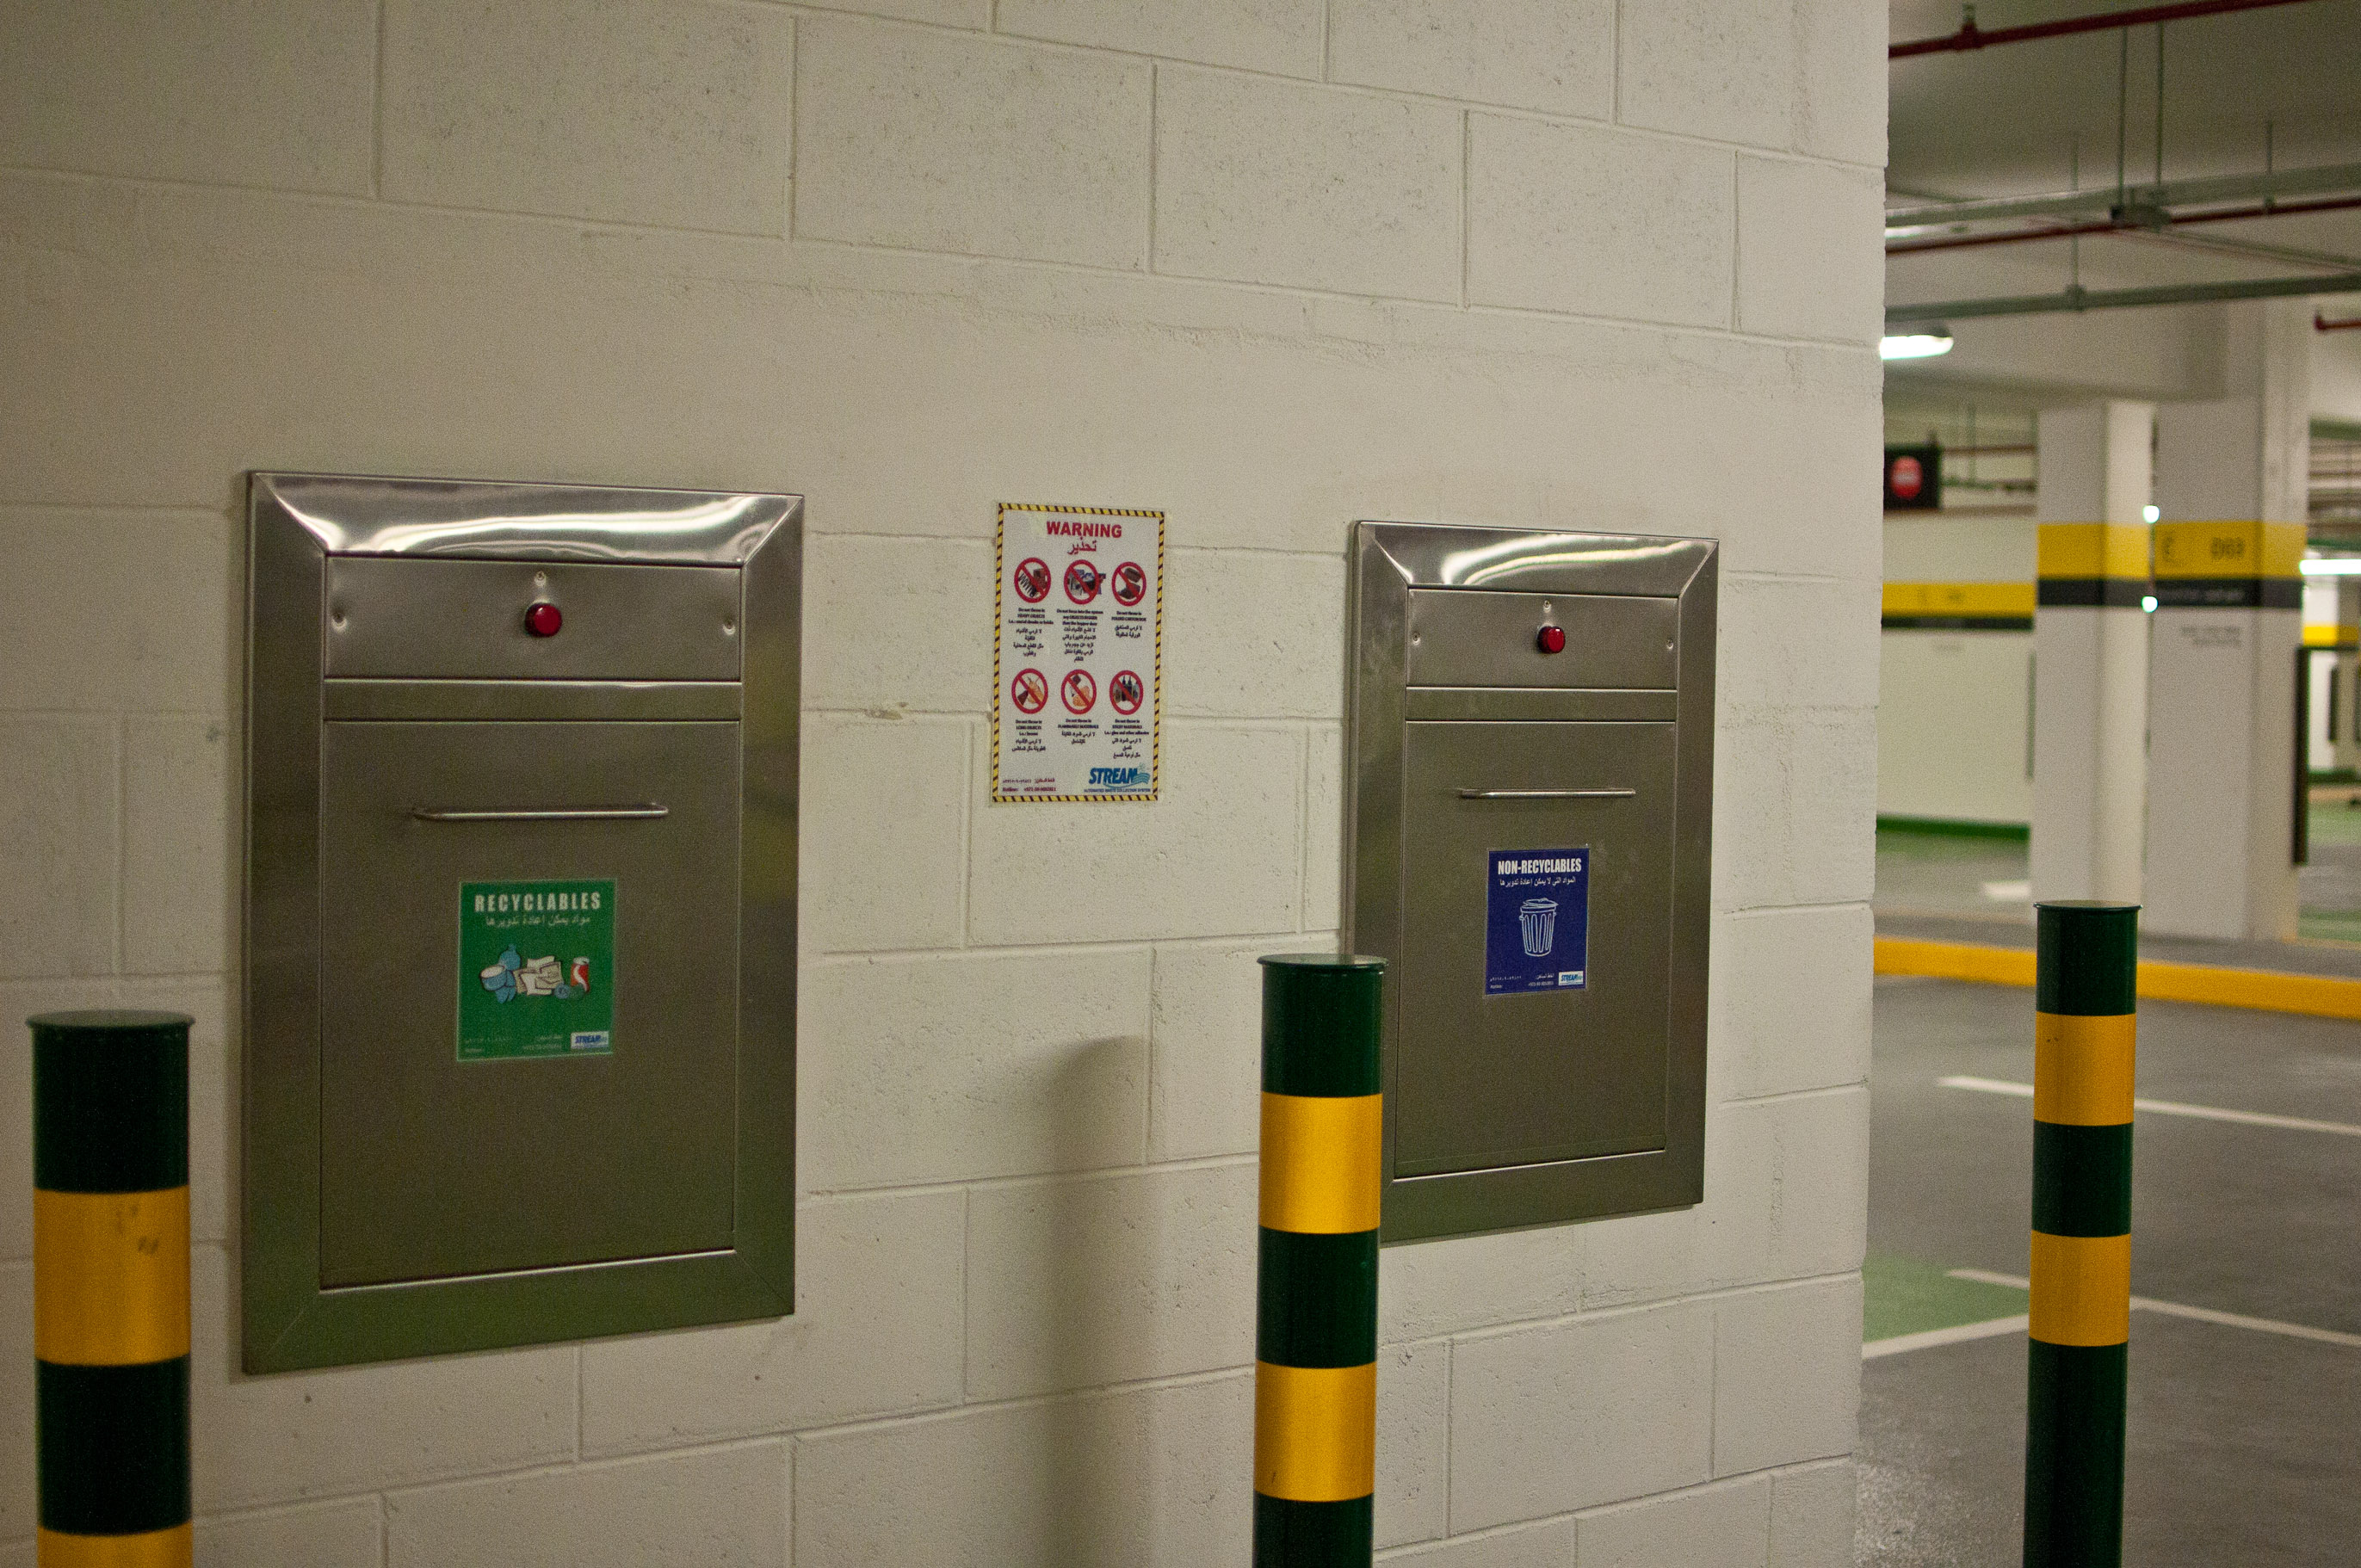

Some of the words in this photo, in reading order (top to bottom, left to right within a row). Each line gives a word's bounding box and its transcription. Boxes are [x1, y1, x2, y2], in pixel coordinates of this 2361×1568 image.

[1046, 521, 1122, 538] WARNING
[1067, 536, 1097, 555] تحذير
[1088, 767, 1138, 785] STREAM
[1498, 858, 1582, 875] NON-RECYCLABLES
[474, 892, 602, 912] RECYCLABLES
